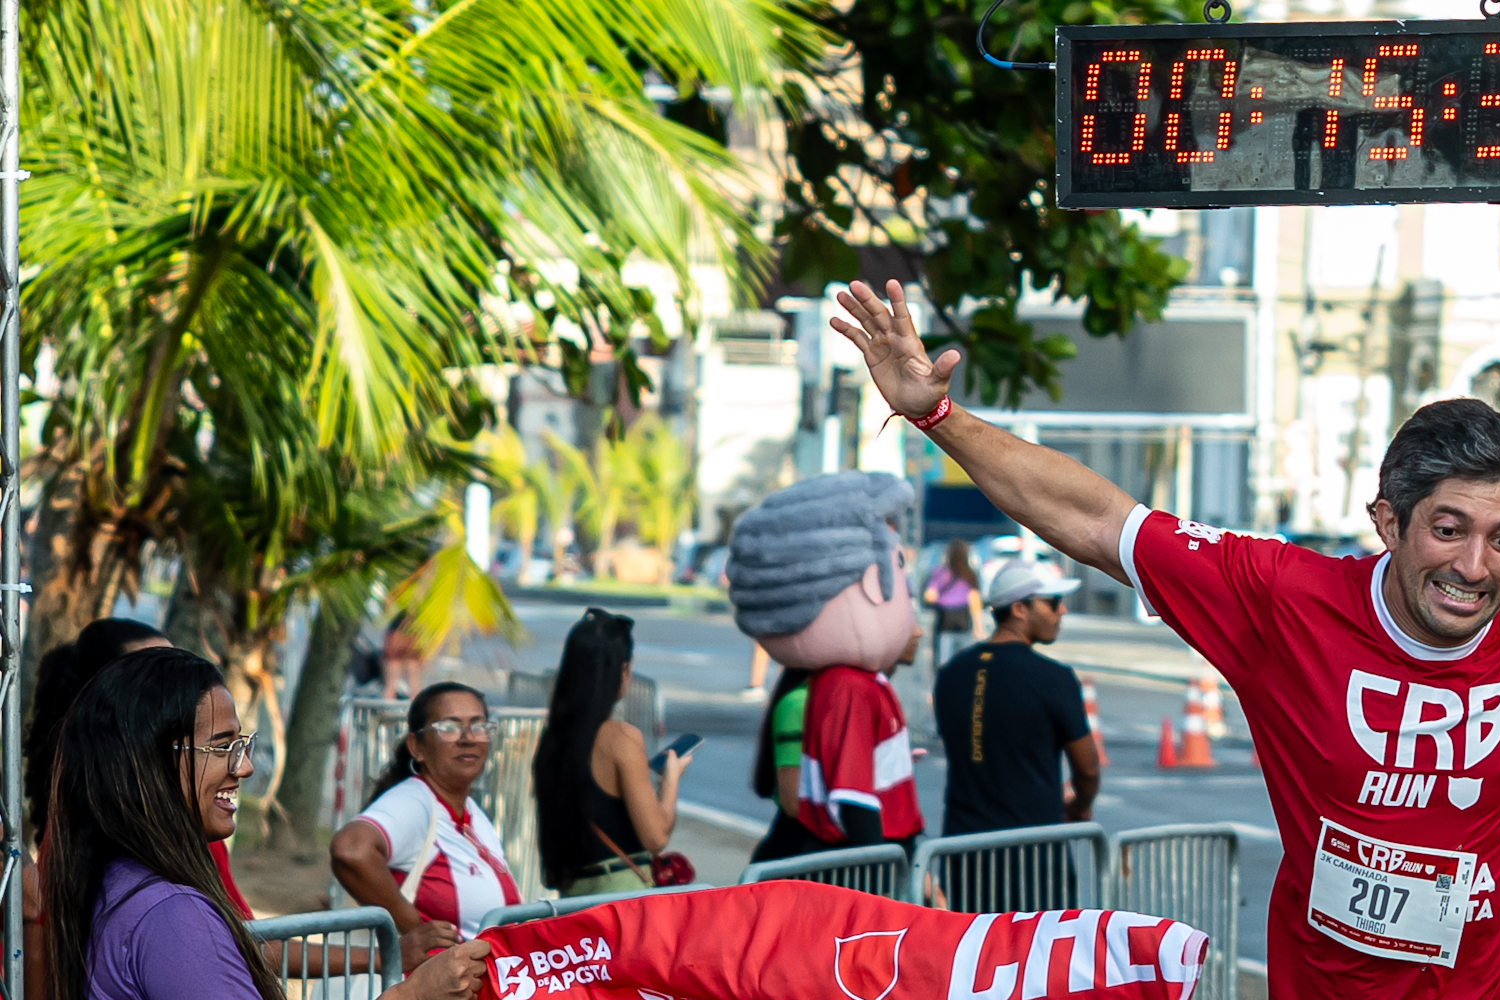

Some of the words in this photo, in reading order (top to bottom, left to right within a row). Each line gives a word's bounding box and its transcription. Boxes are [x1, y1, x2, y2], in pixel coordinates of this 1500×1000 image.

[1357, 771, 1437, 808] RUN
[1320, 853, 1333, 864] 3K
[1333, 859, 1388, 882] CAMINHADA
[1357, 840, 1406, 872] CRB
[1401, 861, 1424, 873] RUN
[1348, 877, 1410, 924] 207
[1356, 916, 1386, 934] THIAGO
[530, 937, 611, 975] BOLSA
[537, 977, 549, 987] DE
